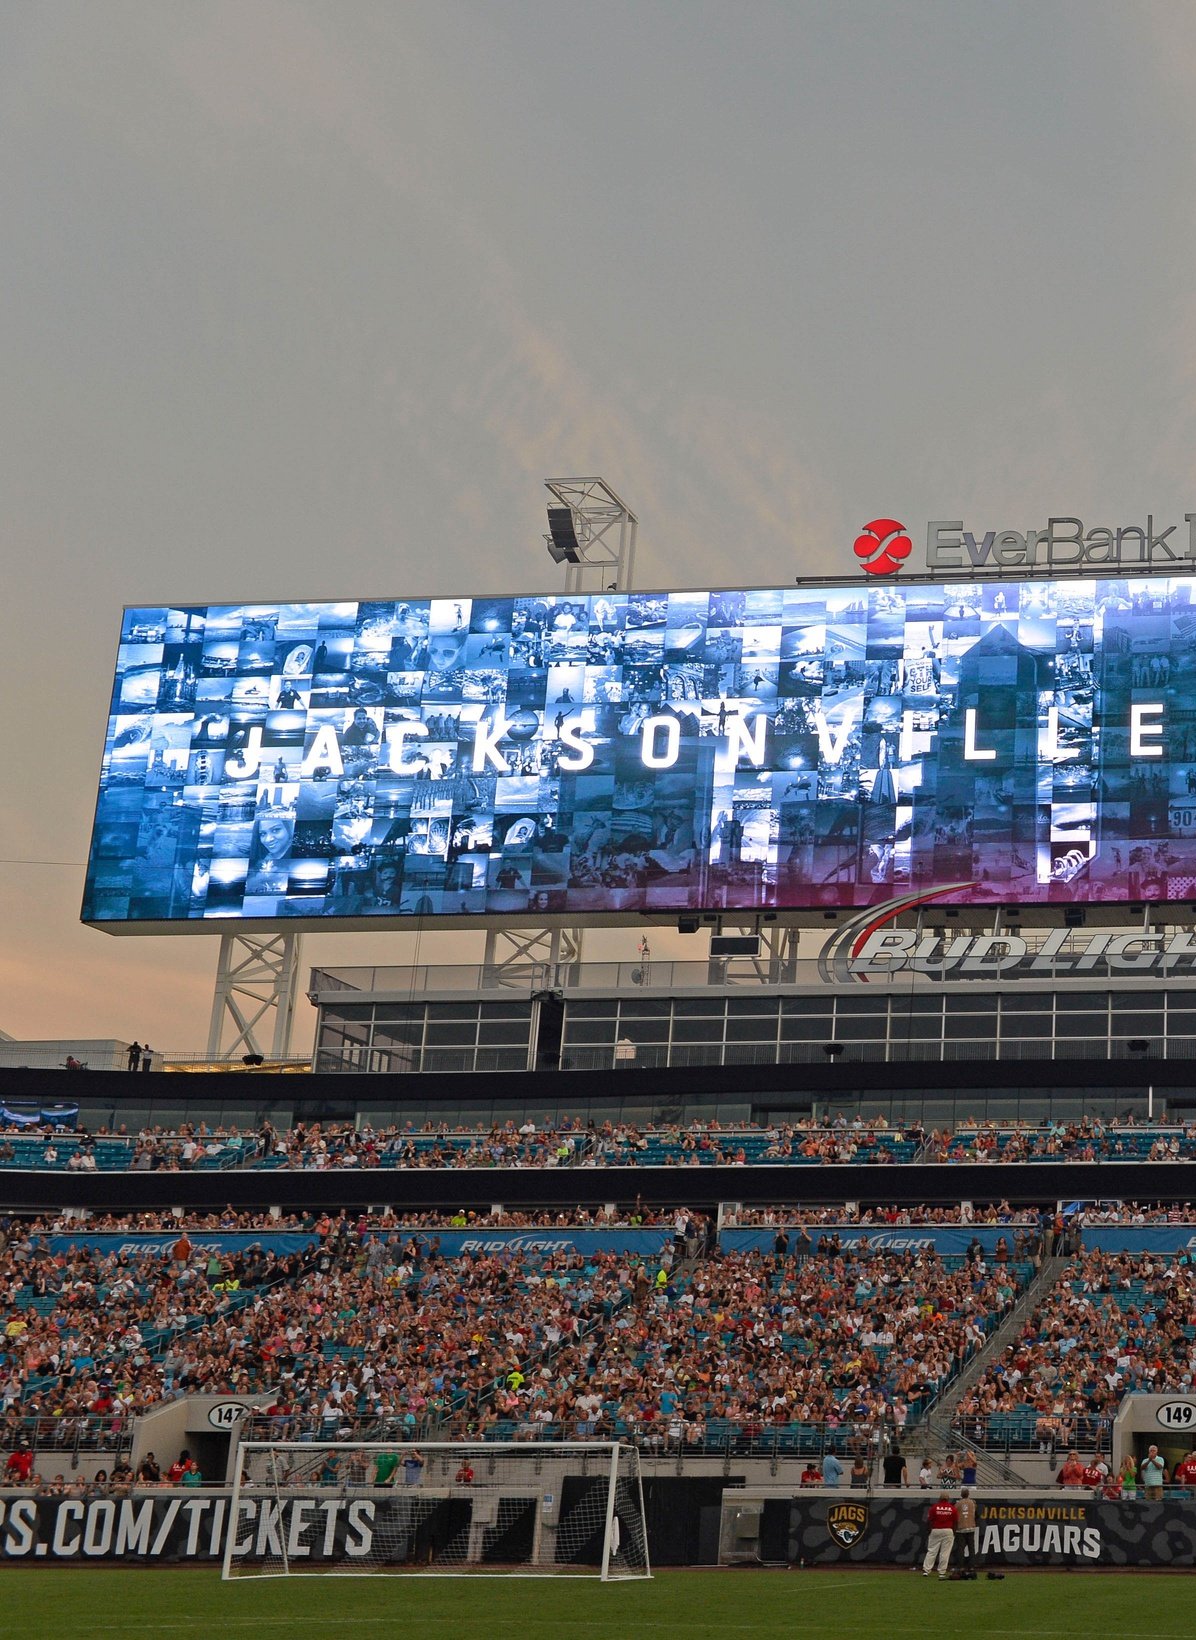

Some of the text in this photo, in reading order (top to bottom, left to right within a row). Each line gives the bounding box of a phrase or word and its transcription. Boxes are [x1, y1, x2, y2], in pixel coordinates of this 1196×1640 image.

[926, 515, 1178, 568] EverBank
[910, 684, 931, 692] SELF
[224, 703, 1164, 779] JACKSONVILLE
[848, 930, 1028, 973] BUD
[118, 1243, 160, 1254] BUD
[459, 1240, 573, 1251] BUD LIGHT
[875, 1238, 937, 1249] LIGHT
[217, 1407, 244, 1423] 147
[1165, 1406, 1193, 1423] 149
[830, 1506, 865, 1522] JAGS
[981, 1507, 1086, 1520] JACKSONVILLE
[0, 1499, 377, 1556] S.COM/TICKETS
